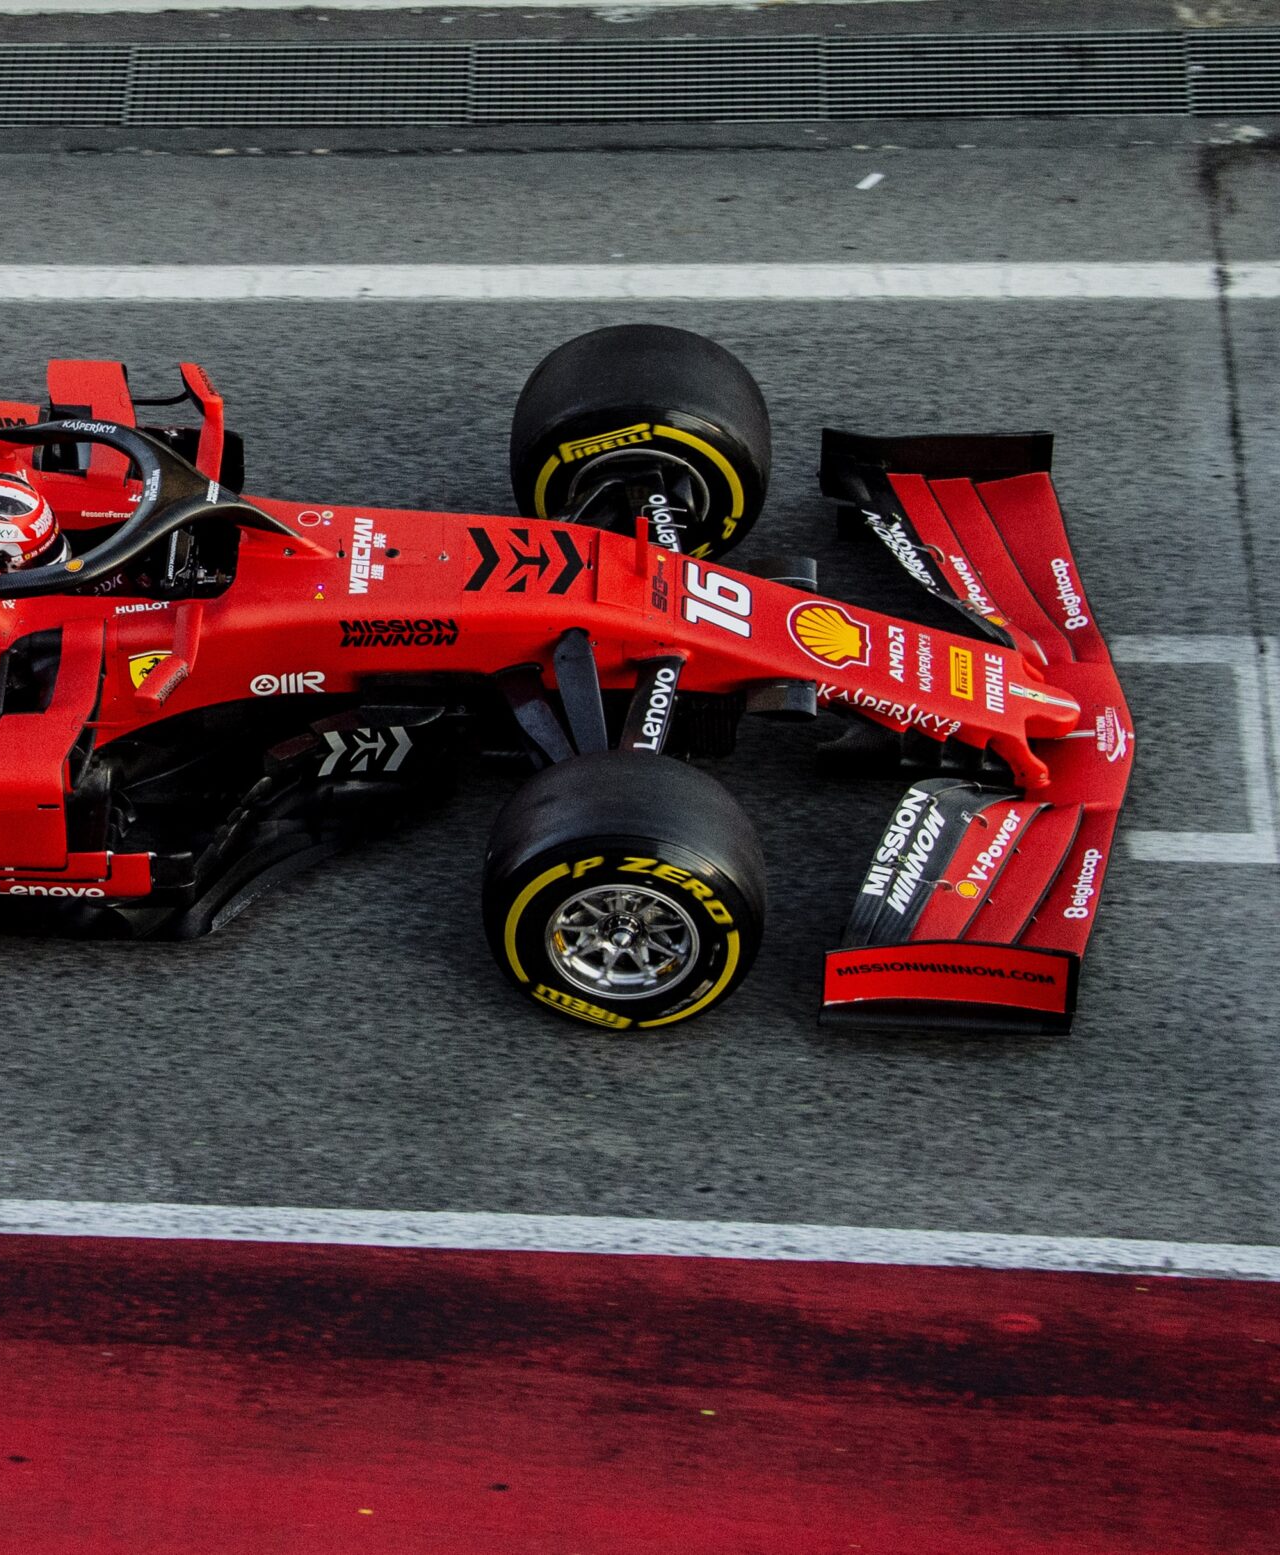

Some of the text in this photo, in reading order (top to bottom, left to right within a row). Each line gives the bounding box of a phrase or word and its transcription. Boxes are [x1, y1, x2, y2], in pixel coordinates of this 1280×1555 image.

[558, 423, 653, 464] PIRELLI
[348, 517, 374, 594] WEICHAI
[115, 601, 170, 615] HUBLOT
[682, 561, 751, 638] 16
[1051, 558, 1080, 617] eightcap
[339, 618, 459, 635] MISSION
[340, 632, 458, 648] WINNOW
[889, 642, 905, 683] AMD
[917, 640, 934, 693] KASPERSKY
[955, 652, 968, 695] PIRELLI
[984, 652, 1005, 714] MAHLE
[633, 667, 676, 751] Lenovo
[817, 683, 949, 733] KASPERSKY
[862, 787, 929, 896] MISSION
[887, 809, 947, 915] WINNOW
[968, 809, 1021, 881] V-Power
[572, 856, 734, 925] P ZERO
[1073, 849, 1102, 908] eightcap
[835, 961, 1056, 986] MISSIONWINNOW.COM
[531, 983, 633, 1029] PIRELLI
